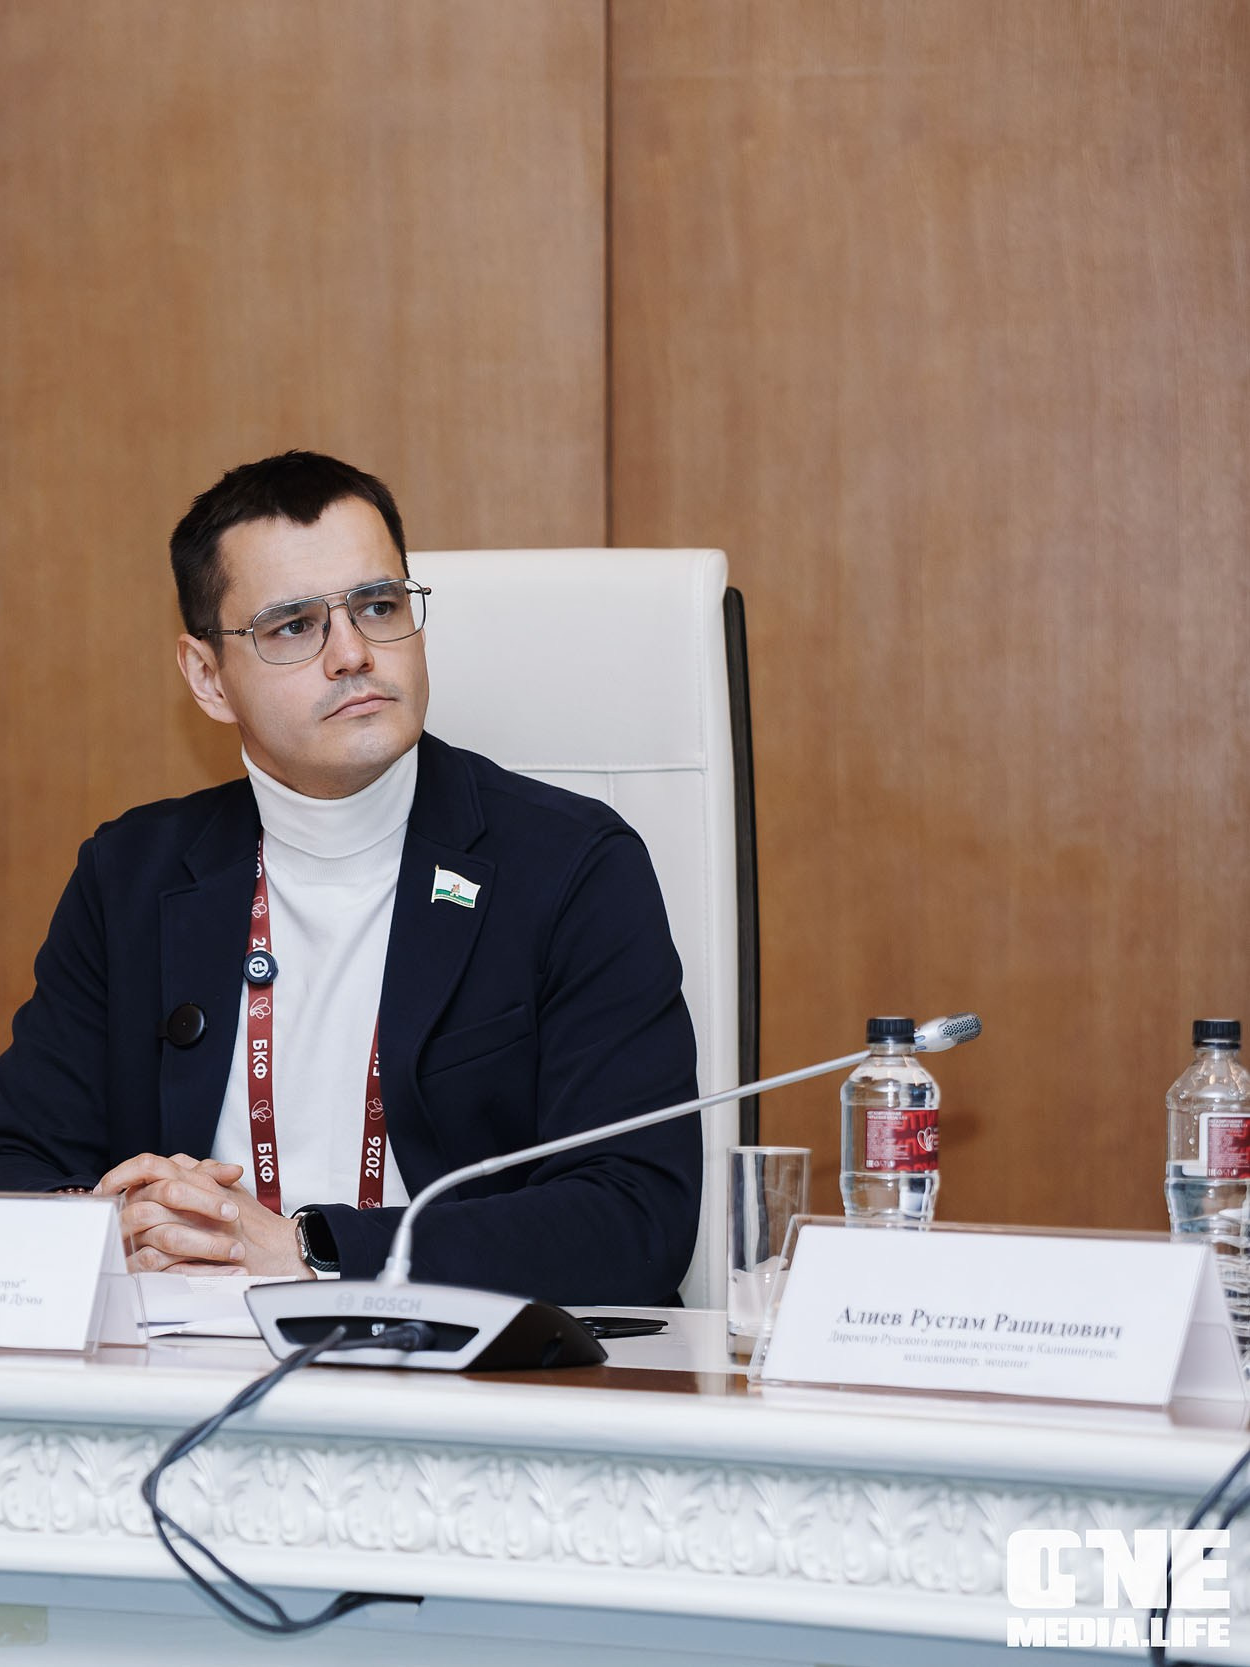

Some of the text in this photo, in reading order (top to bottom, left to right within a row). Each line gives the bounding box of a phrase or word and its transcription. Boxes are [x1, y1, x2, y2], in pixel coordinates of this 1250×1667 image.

[252, 1038, 268, 1080] БКФ
[257, 1142, 275, 1184] БКФ
[365, 1135, 382, 1179] 2026
[362, 1296, 422, 1313] BOSCH
[835, 1304, 1123, 1339] Алиев Рустам Рашидович
